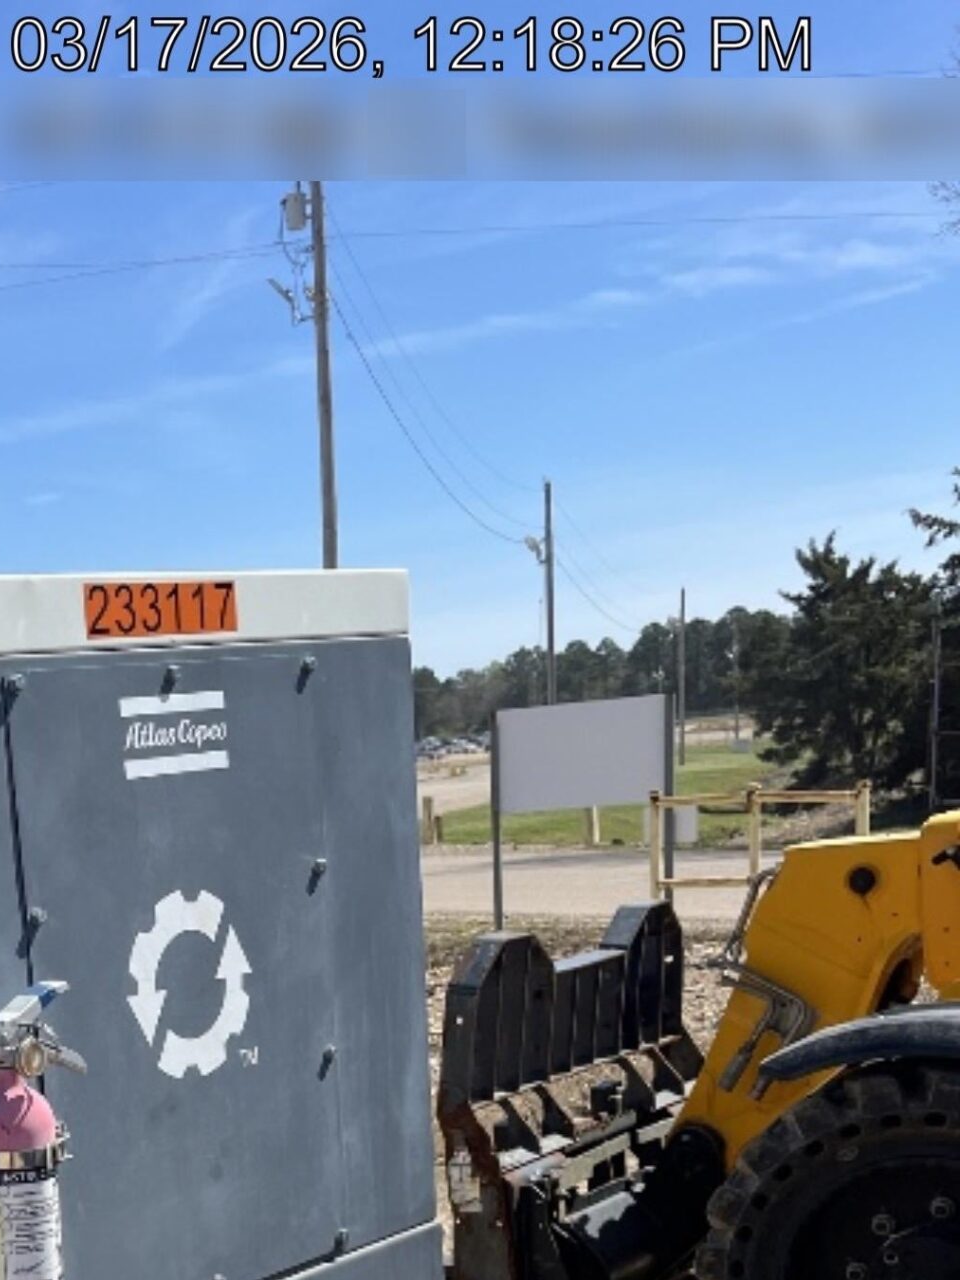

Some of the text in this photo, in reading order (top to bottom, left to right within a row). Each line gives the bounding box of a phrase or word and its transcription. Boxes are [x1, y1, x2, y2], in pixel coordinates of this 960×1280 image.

[87, 583, 234, 635] 233117
[124, 719, 227, 751] Atlas Copco
